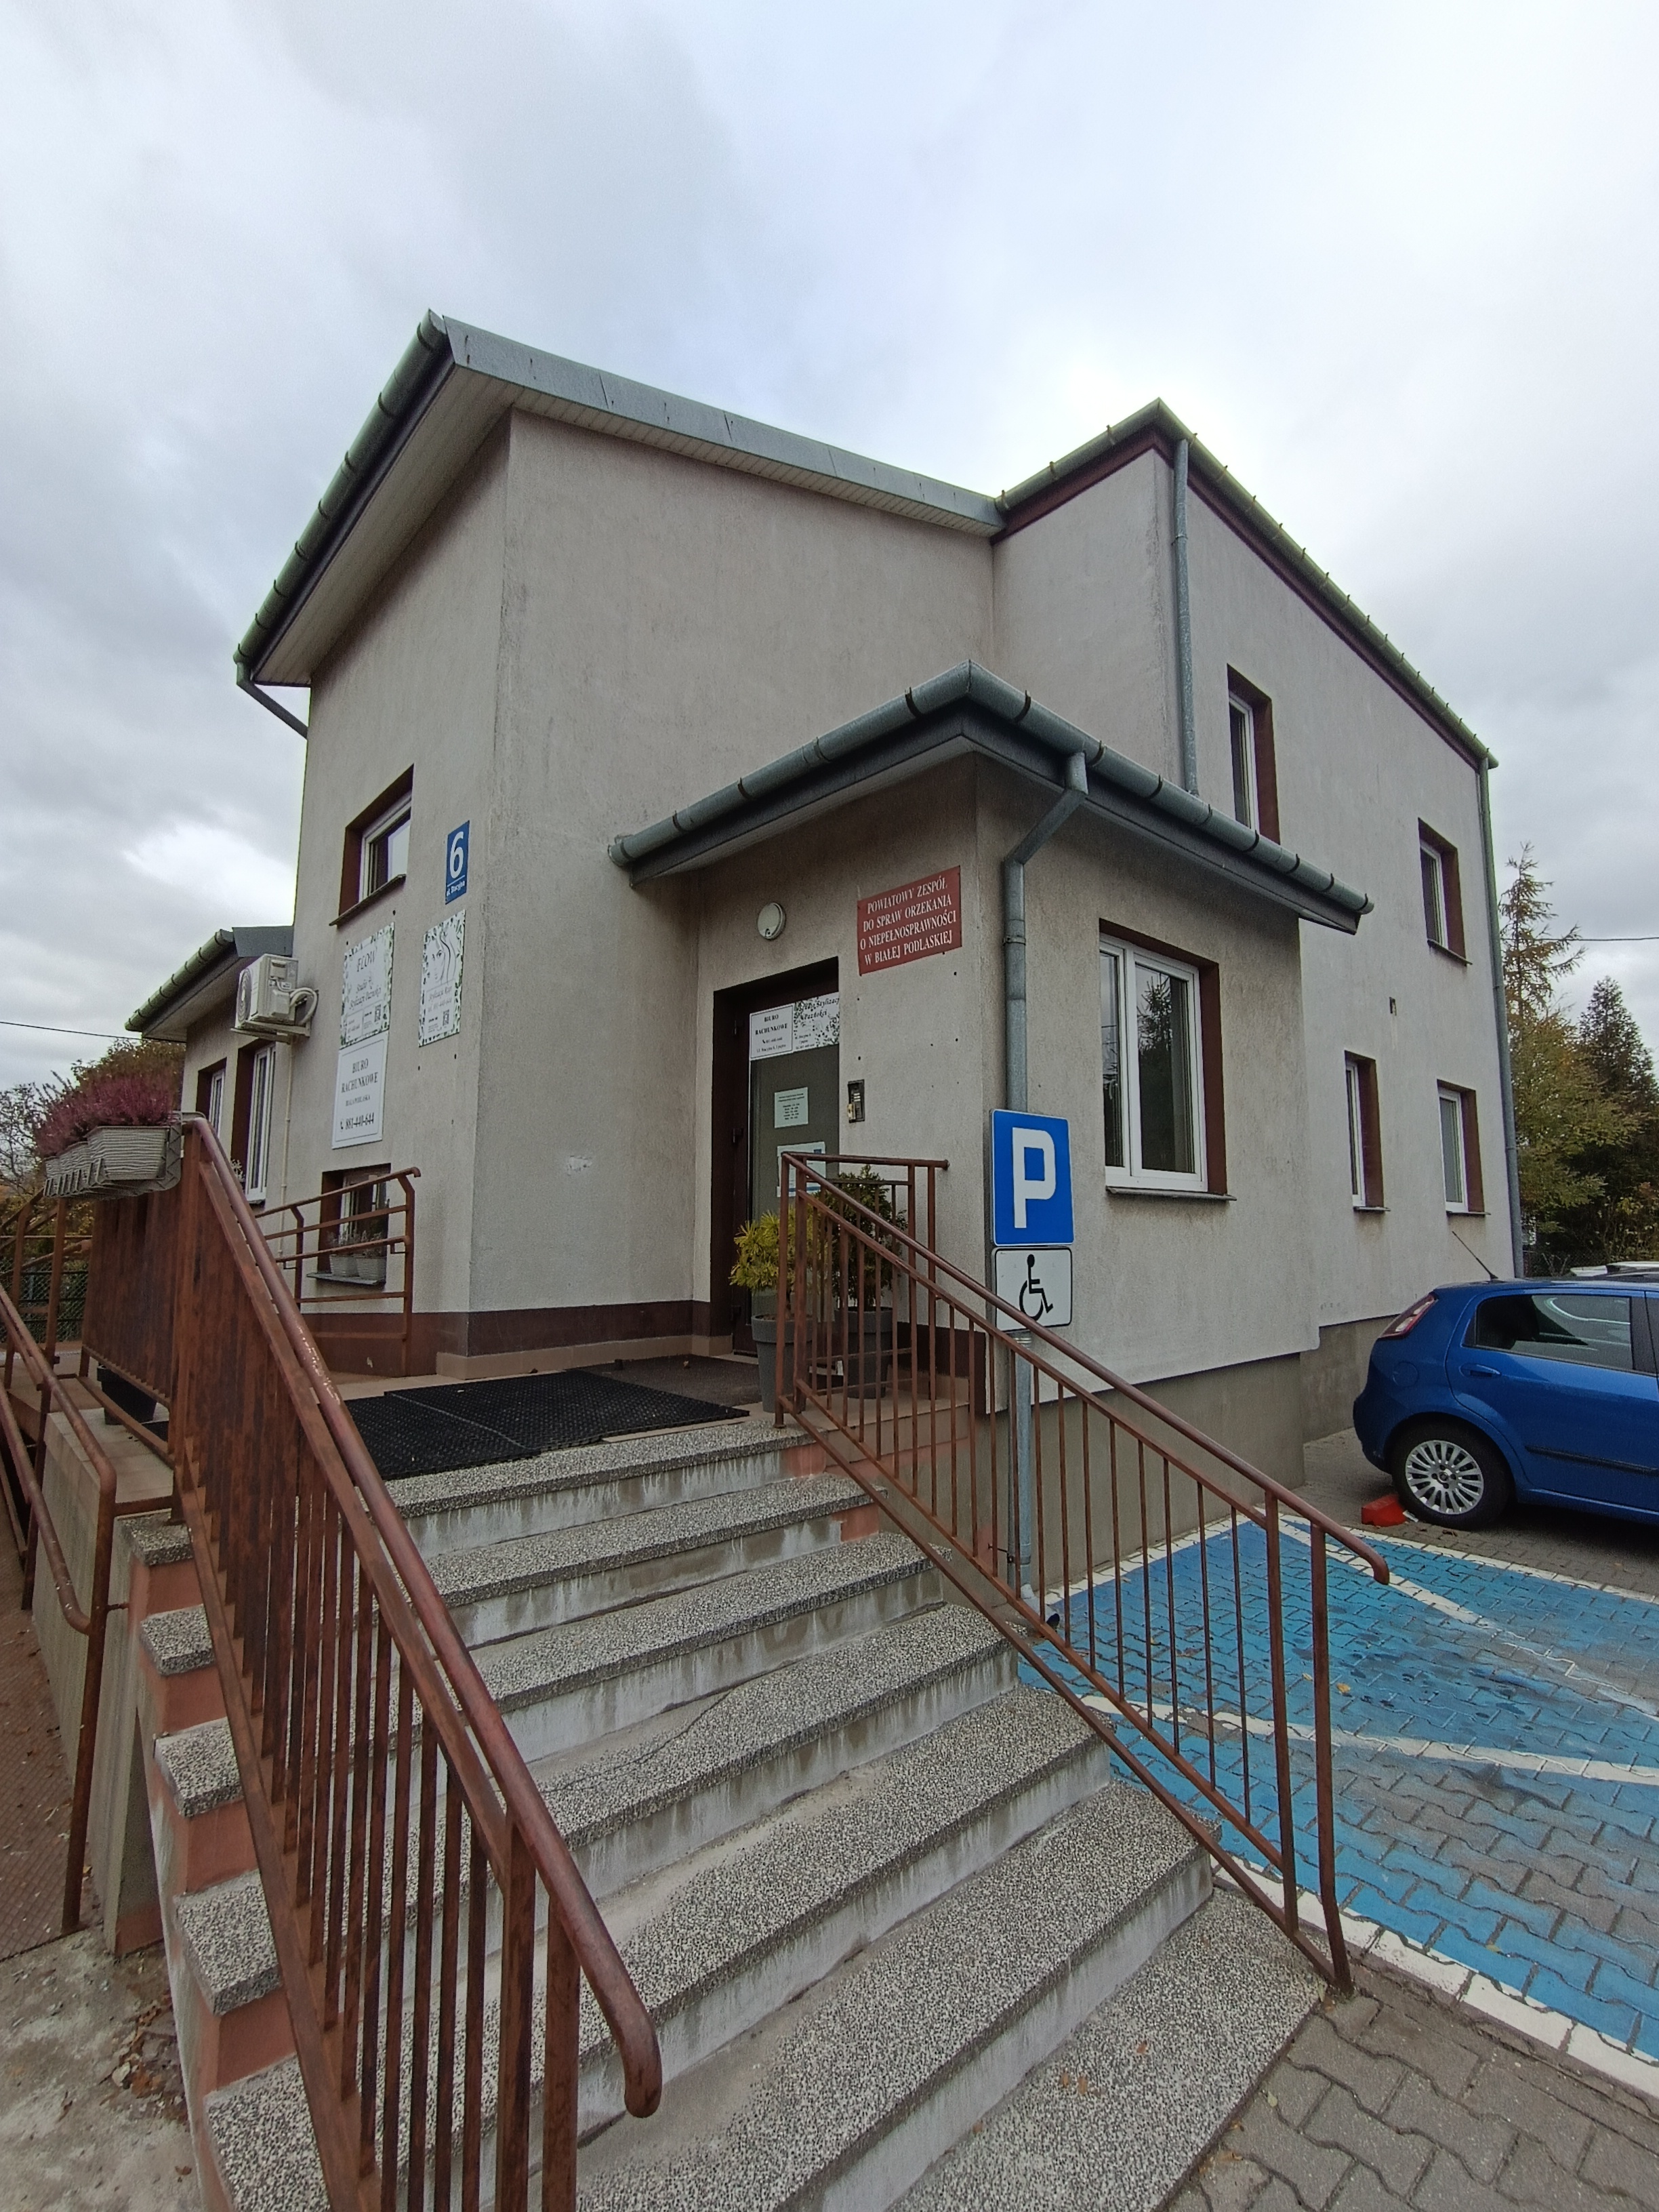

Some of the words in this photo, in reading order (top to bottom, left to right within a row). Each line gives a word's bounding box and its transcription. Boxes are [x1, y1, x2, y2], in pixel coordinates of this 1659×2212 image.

[449, 831, 464, 879] 6
[867, 888, 914, 914] POWIATOWY
[917, 875, 947, 897] ZESPÓŁ
[863, 919, 874, 932] DO
[876, 909, 902, 928] SPRAW
[905, 894, 951, 918] ORZEKANIA
[860, 938, 866, 950] O
[869, 909, 956, 948] NIEPEŁNOSPRAWNOŚCI
[356, 947, 377, 972] FLOW
[865, 954, 872, 966] W
[875, 945, 901, 963] BIAŁEJ
[904, 930, 952, 956] PODLASKIEJ
[764, 1014, 779, 1022] BIURO
[817, 998, 839, 1008] Stylizacj
[755, 1023, 787, 1035] RACHUNKOWE
[352, 1058, 369, 1073] BIURO
[341, 1072, 378, 1093] RACHUNKOWE
[1012, 1127, 1056, 1229] P
